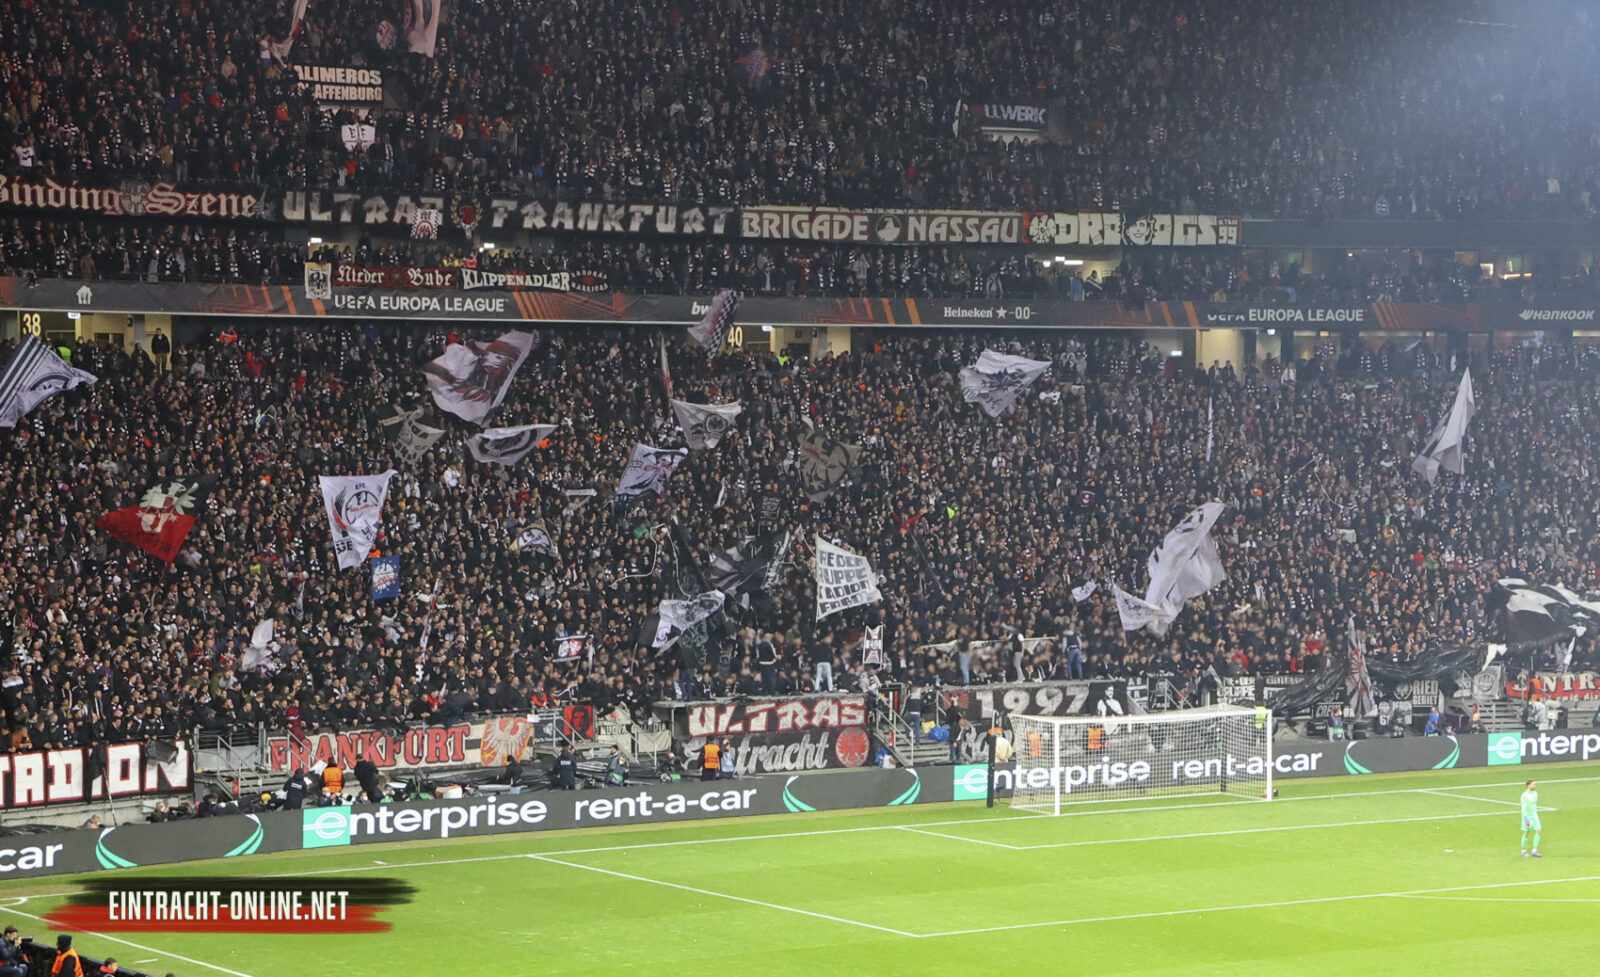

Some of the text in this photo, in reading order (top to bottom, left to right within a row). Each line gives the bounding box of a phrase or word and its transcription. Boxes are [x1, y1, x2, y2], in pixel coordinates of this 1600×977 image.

[146, 181, 257, 218] Szene
[491, 200, 734, 234] FRANKFURT
[742, 211, 1018, 243] BRIGADE NASSAU
[1218, 226, 1237, 244] 99
[461, 268, 570, 291] KLIPPENADLER
[334, 294, 505, 313] UEFA EUROPA LEAGUE
[944, 307, 993, 319] Heineken
[1249, 308, 1305, 322] EUROPA
[1308, 309, 1364, 322] LEAGUE
[23, 313, 41, 336] 38
[728, 326, 743, 347] 40
[1412, 680, 1439, 695] RIED
[689, 697, 866, 737] ULTRAS
[976, 688, 1089, 718] 1997
[268, 724, 471, 773] FRANKFURT
[683, 731, 830, 776] Etracht
[954, 752, 1323, 794] enterprise rent-a-car
[303, 787, 757, 839] enterprise rent-a-car
